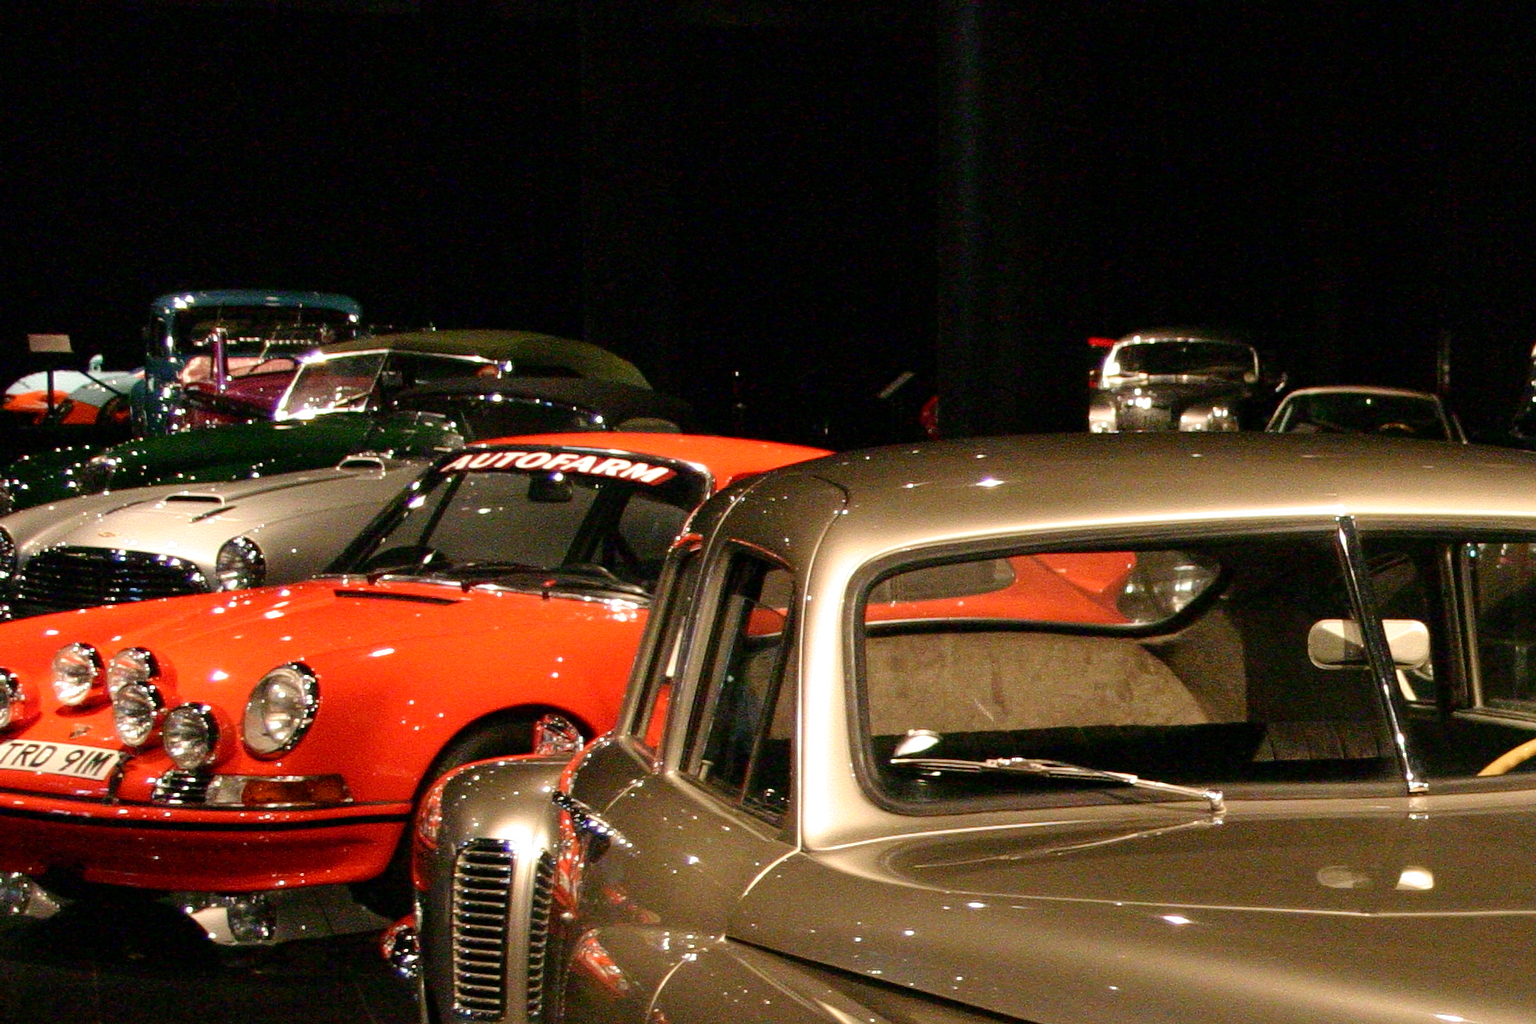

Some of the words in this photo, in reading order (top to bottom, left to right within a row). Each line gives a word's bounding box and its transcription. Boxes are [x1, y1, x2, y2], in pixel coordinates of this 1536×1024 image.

[439, 451, 671, 483] AUTOFARM
[0, 742, 58, 768] TRD
[58, 749, 116, 777] 91M
